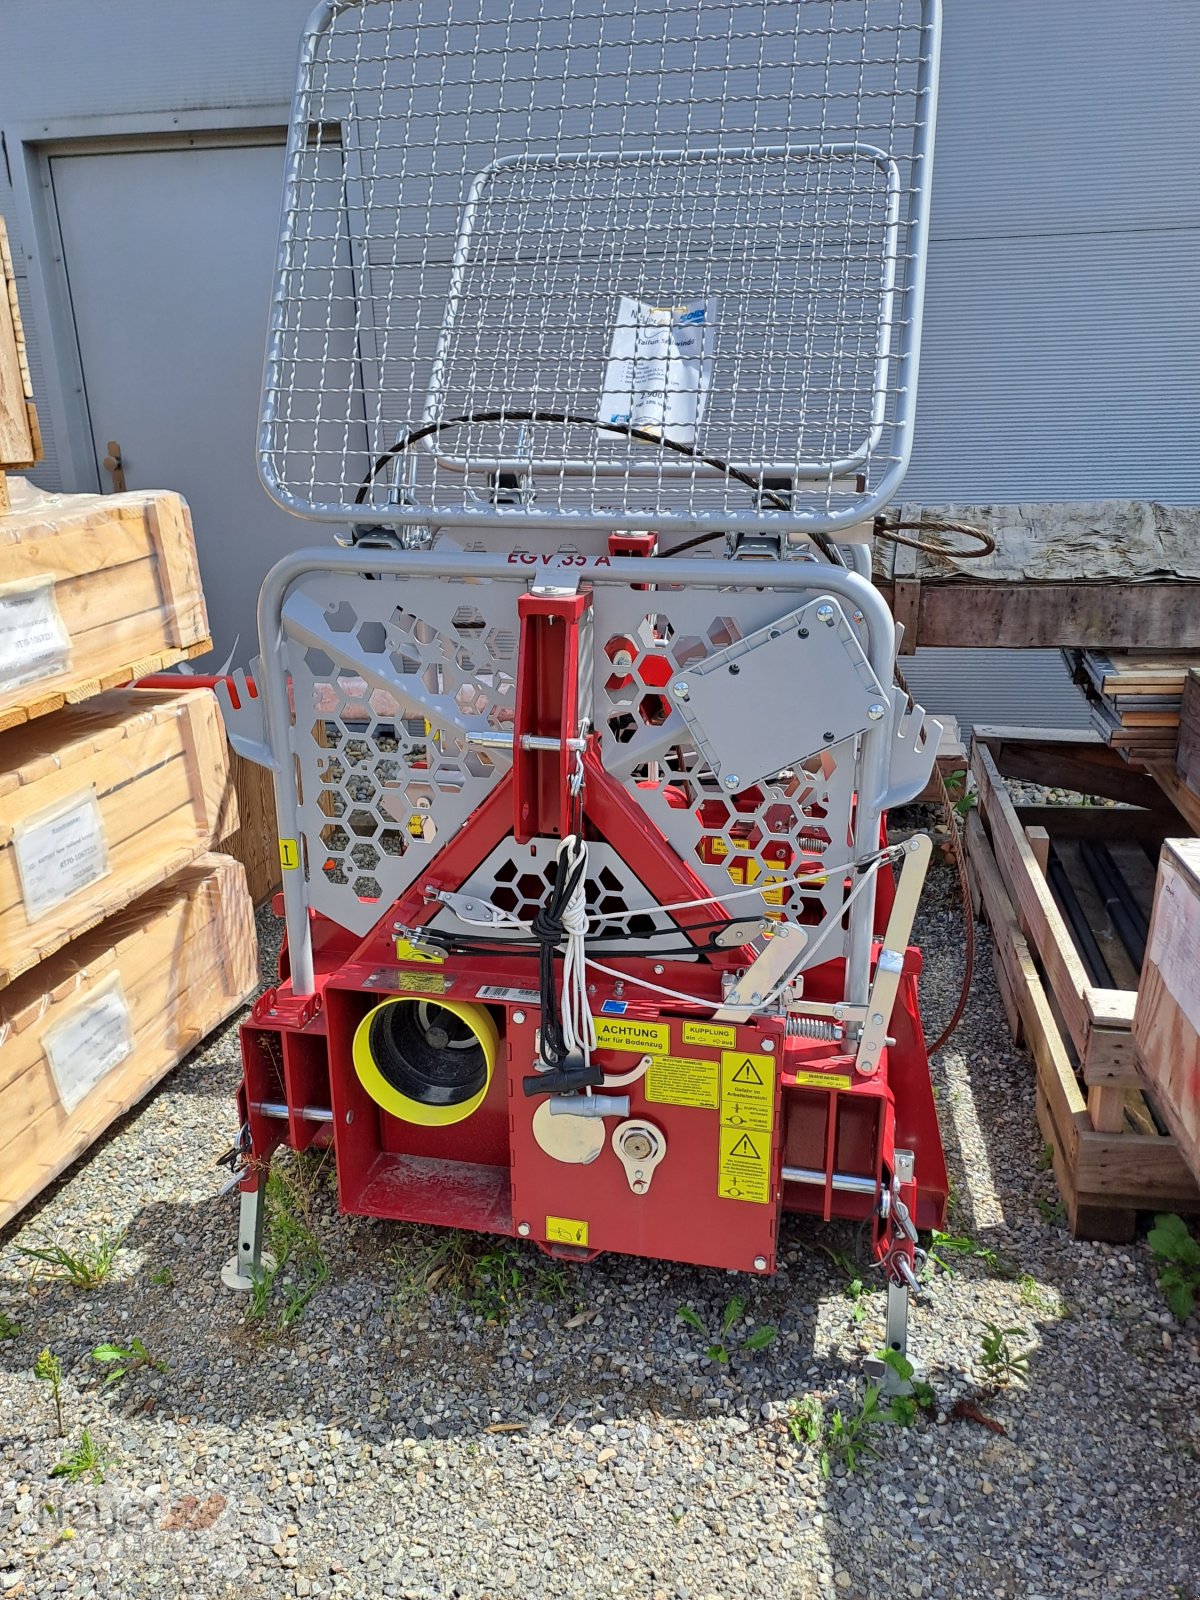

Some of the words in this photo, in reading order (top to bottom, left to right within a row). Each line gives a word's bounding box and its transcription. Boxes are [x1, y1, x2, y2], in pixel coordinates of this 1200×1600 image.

[602, 1025, 658, 1039] ACHTUNG
[690, 1027, 730, 1037] KUPPLUNG
[612, 1036, 623, 1044] für
[625, 1038, 663, 1049] Bodenzug
